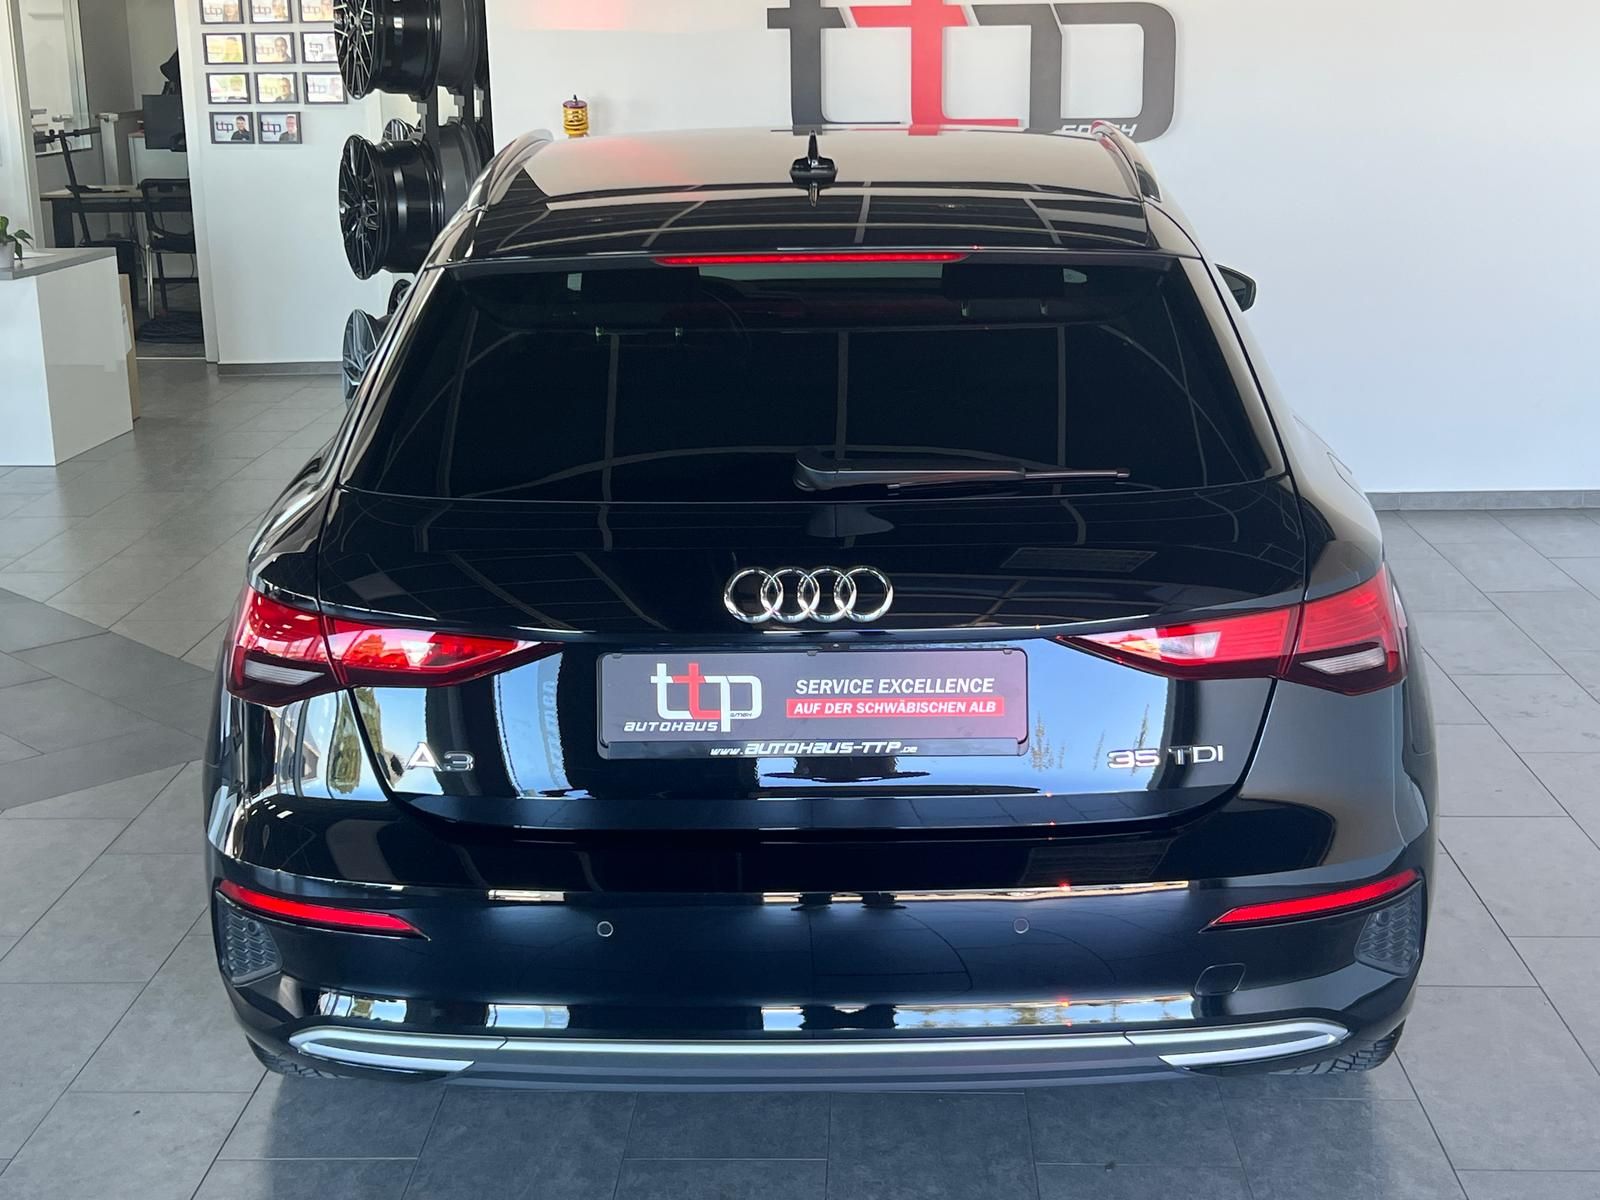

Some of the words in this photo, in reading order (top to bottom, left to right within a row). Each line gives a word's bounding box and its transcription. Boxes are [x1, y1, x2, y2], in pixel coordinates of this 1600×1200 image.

[795, 678, 874, 695] SERVICE
[877, 677, 995, 694] EXCELLENCE
[794, 702, 822, 714] AUF
[824, 702, 852, 714] DER
[856, 700, 967, 714] SCHWÄBISCHEN
[969, 701, 996, 713] ALB
[405, 741, 475, 772] A3
[1107, 748, 1160, 769] 35
[1167, 744, 1224, 766] TDI
